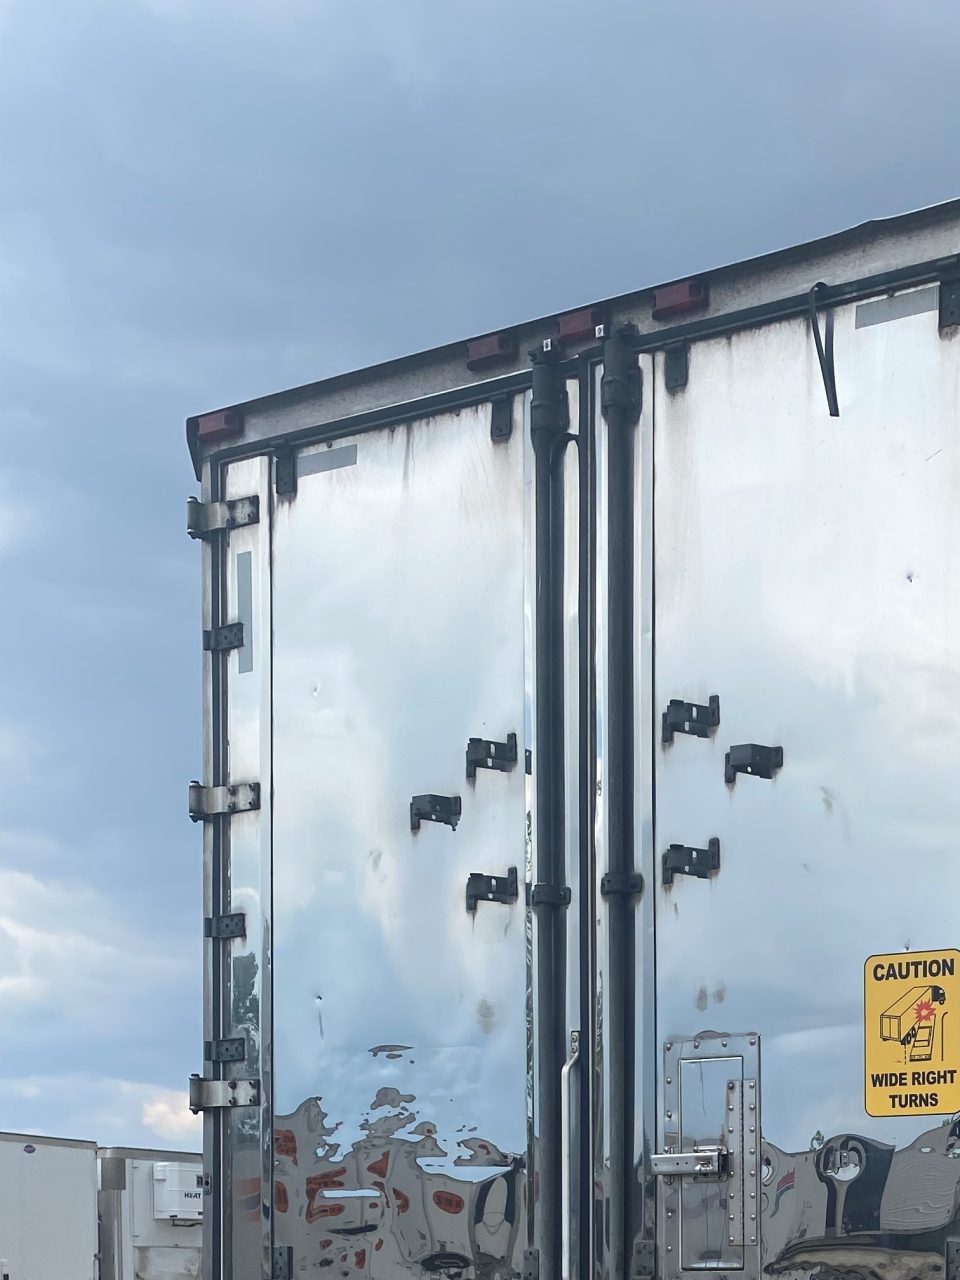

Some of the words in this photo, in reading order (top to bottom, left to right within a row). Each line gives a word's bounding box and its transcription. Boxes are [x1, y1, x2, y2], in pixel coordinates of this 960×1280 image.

[873, 958, 955, 982] CAUTION
[871, 1071, 908, 1087] WIDE
[911, 1069, 957, 1086] RIGHT
[889, 1092, 939, 1109] TURNS
